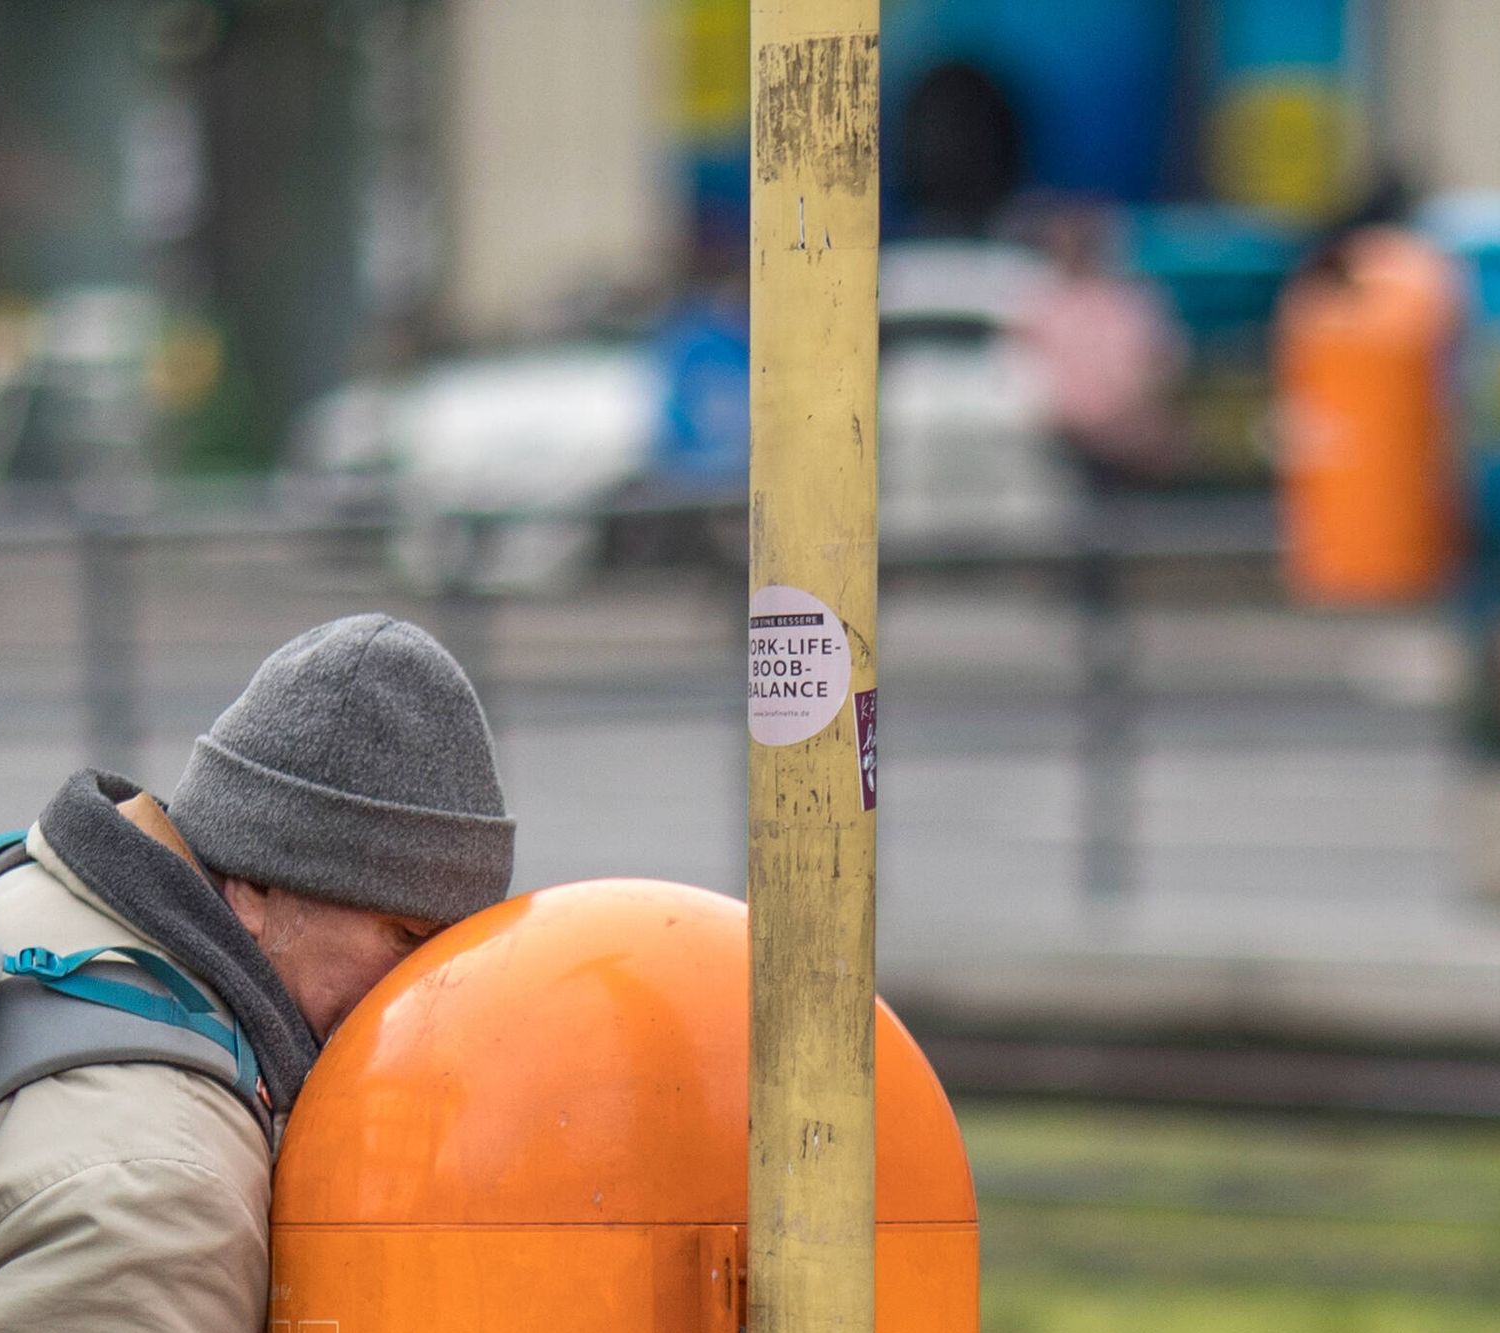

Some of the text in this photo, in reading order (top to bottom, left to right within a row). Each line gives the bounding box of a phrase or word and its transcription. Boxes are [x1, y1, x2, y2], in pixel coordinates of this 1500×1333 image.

[777, 614, 818, 626] BESSERE
[750, 638, 841, 655] ORK-LIFE-
[752, 660, 812, 677] BOOB-
